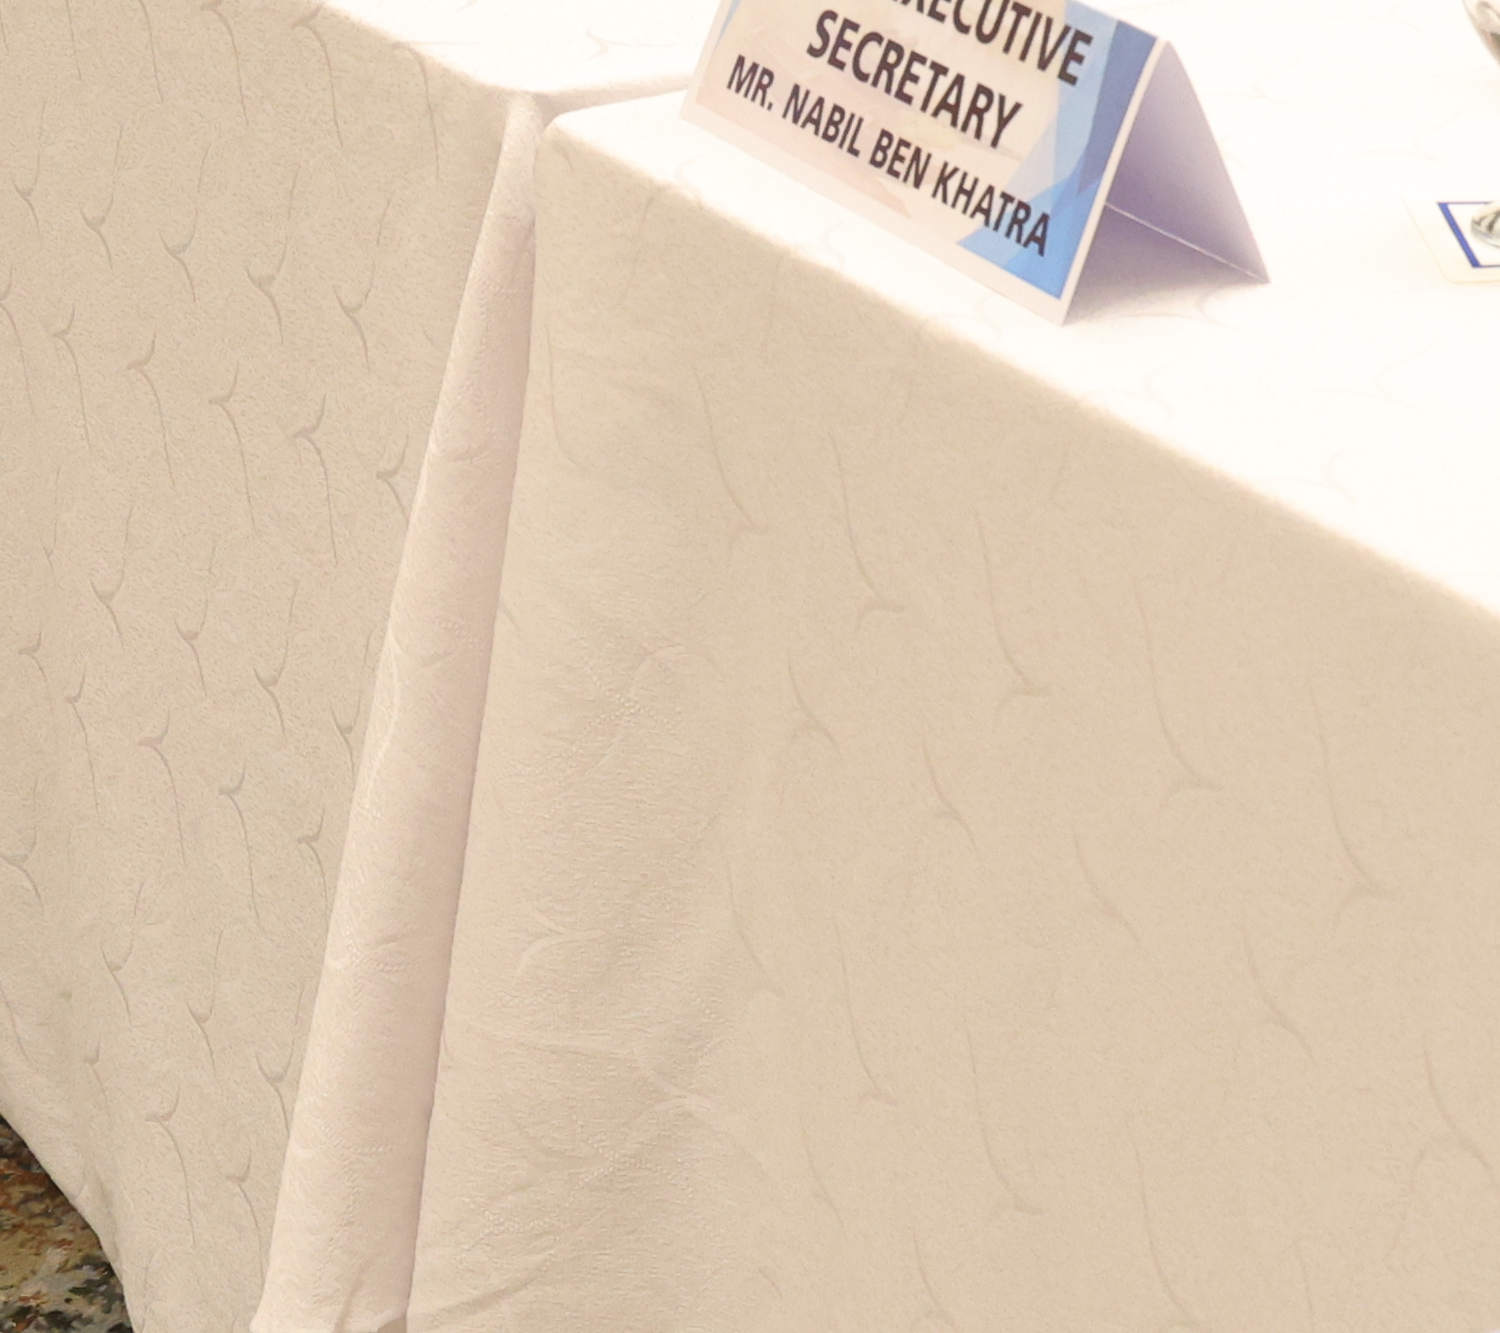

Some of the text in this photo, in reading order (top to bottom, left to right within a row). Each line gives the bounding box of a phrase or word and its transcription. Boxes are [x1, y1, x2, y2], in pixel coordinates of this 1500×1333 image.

[727, 55, 1050, 256] MR. NABIL BEN KHATRA
[807, 9, 1022, 148] SECRETARY
